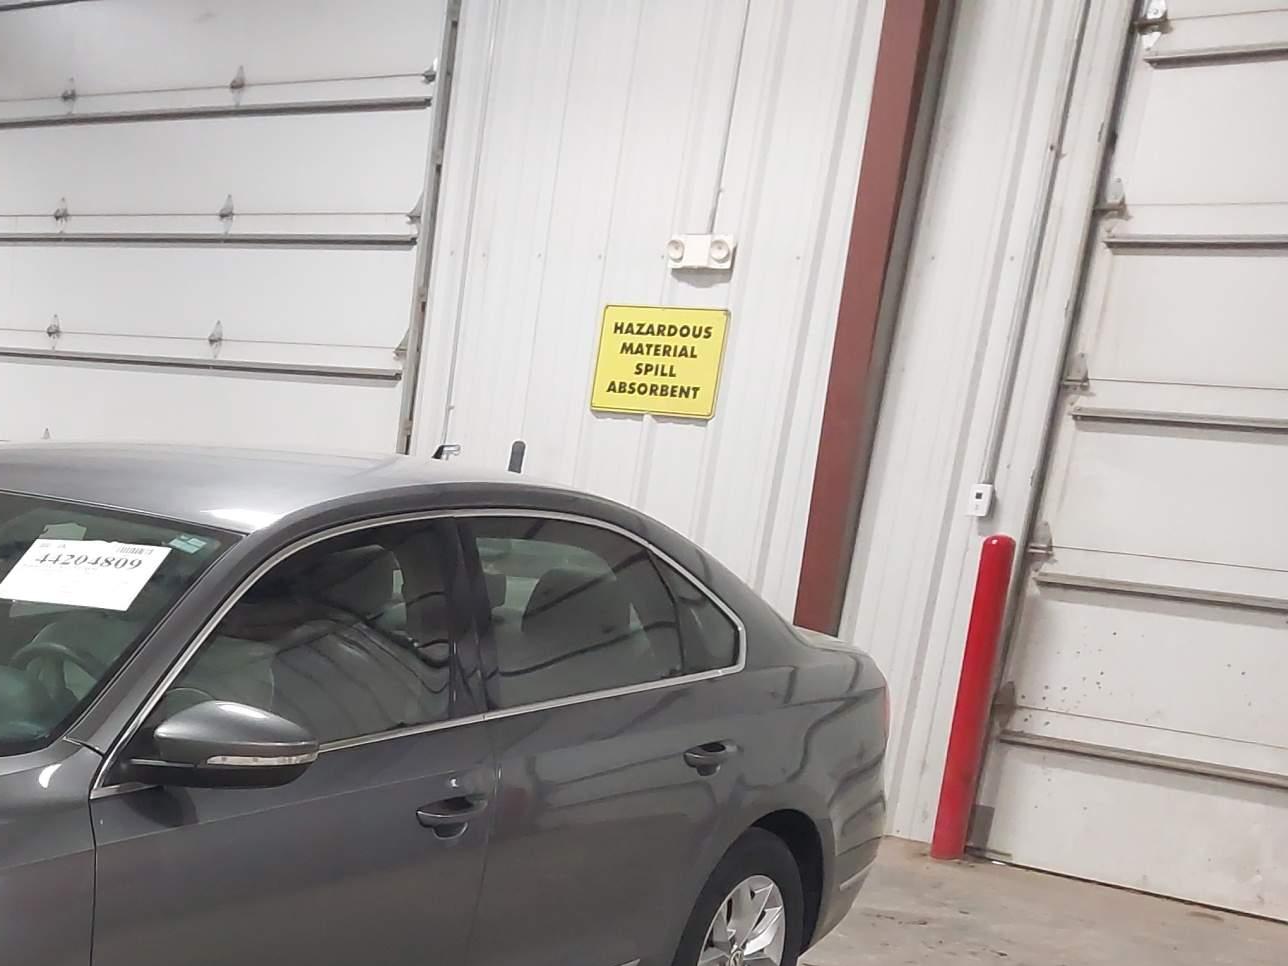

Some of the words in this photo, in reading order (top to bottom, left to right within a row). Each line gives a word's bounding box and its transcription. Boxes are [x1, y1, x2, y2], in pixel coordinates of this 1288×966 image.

[613, 322, 713, 339] HAZARDOUS
[619, 342, 698, 359] MATERIAL
[634, 362, 677, 378] SPILL
[606, 380, 701, 399] ABSORBENT
[36, 552, 143, 570] 44204809
